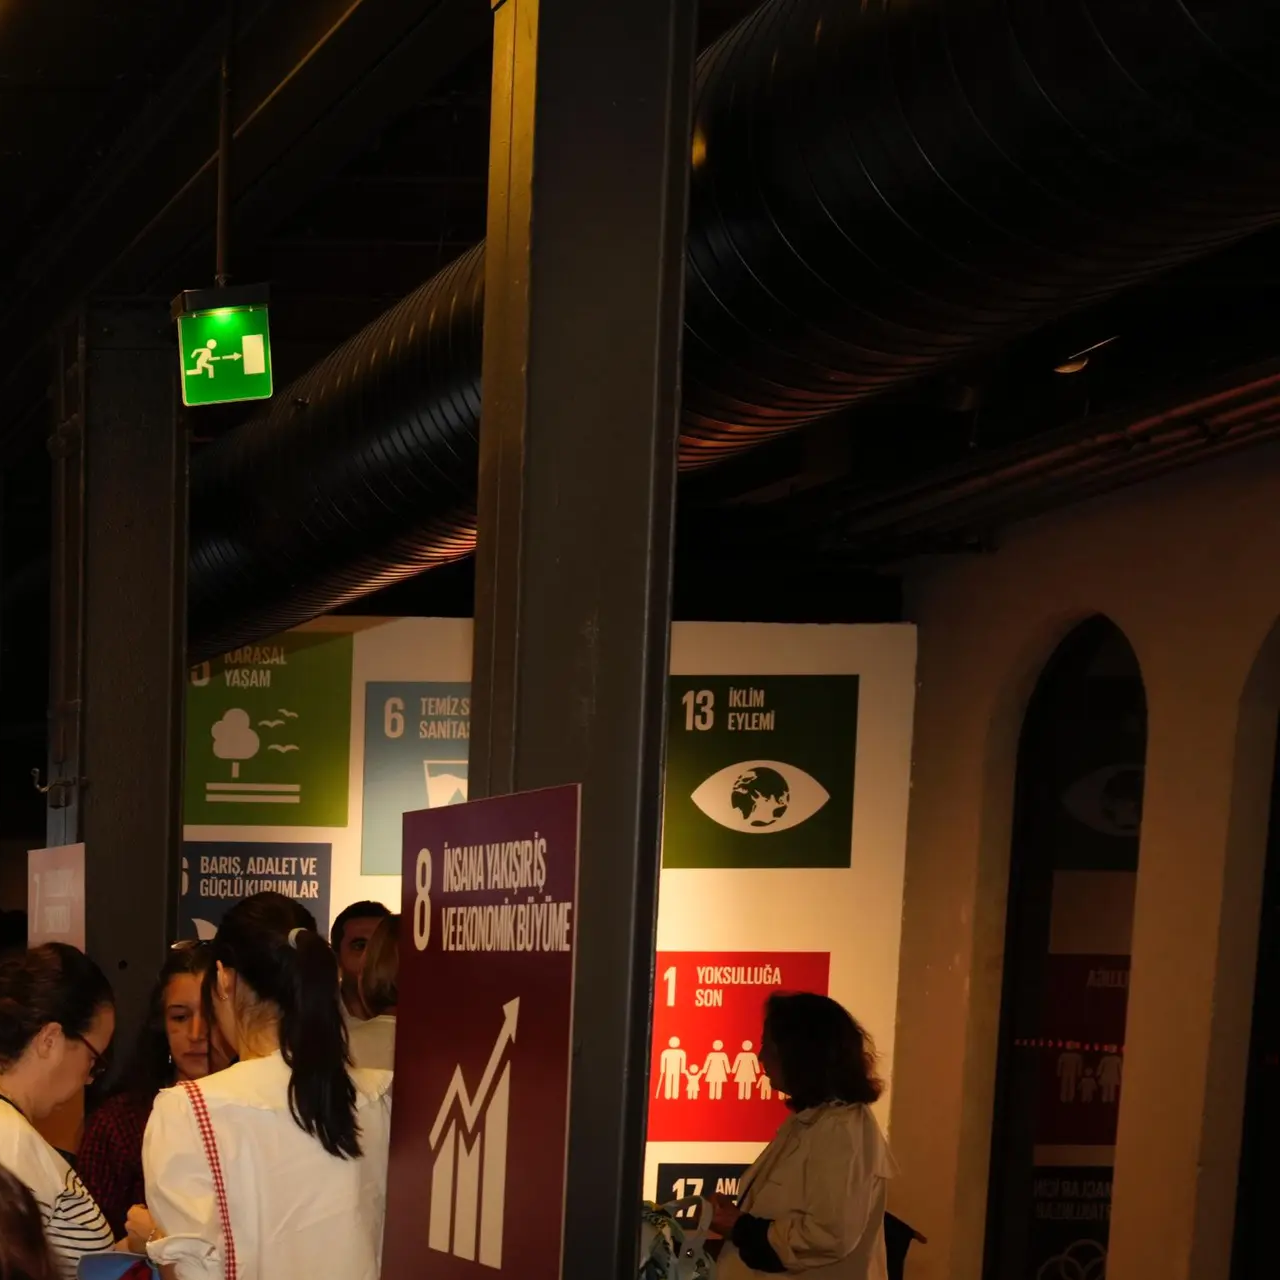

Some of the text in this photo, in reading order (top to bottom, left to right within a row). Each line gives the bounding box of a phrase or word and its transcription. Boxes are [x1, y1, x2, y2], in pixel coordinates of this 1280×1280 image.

[224, 669, 271, 688] YAŞAM
[420, 695, 458, 716] TEMİZ
[729, 687, 765, 707] İKLİM
[384, 697, 405, 738] 6
[682, 690, 714, 731] 13
[728, 710, 775, 731] EYLEMİ
[200, 856, 244, 879] BARIŞ,
[246, 857, 298, 876] ADALET
[300, 857, 317, 876] VE
[443, 842, 485, 892] İNSANA
[486, 840, 533, 895] YAKIŞIR
[200, 876, 243, 899] GÜÇLÜ
[414, 848, 432, 951] 8
[442, 896, 572, 952] VE EKONOMİK BÜYÜME
[697, 964, 782, 985] YOKSULLUĞA
[664, 966, 677, 1007] 1
[695, 989, 723, 1007] SON
